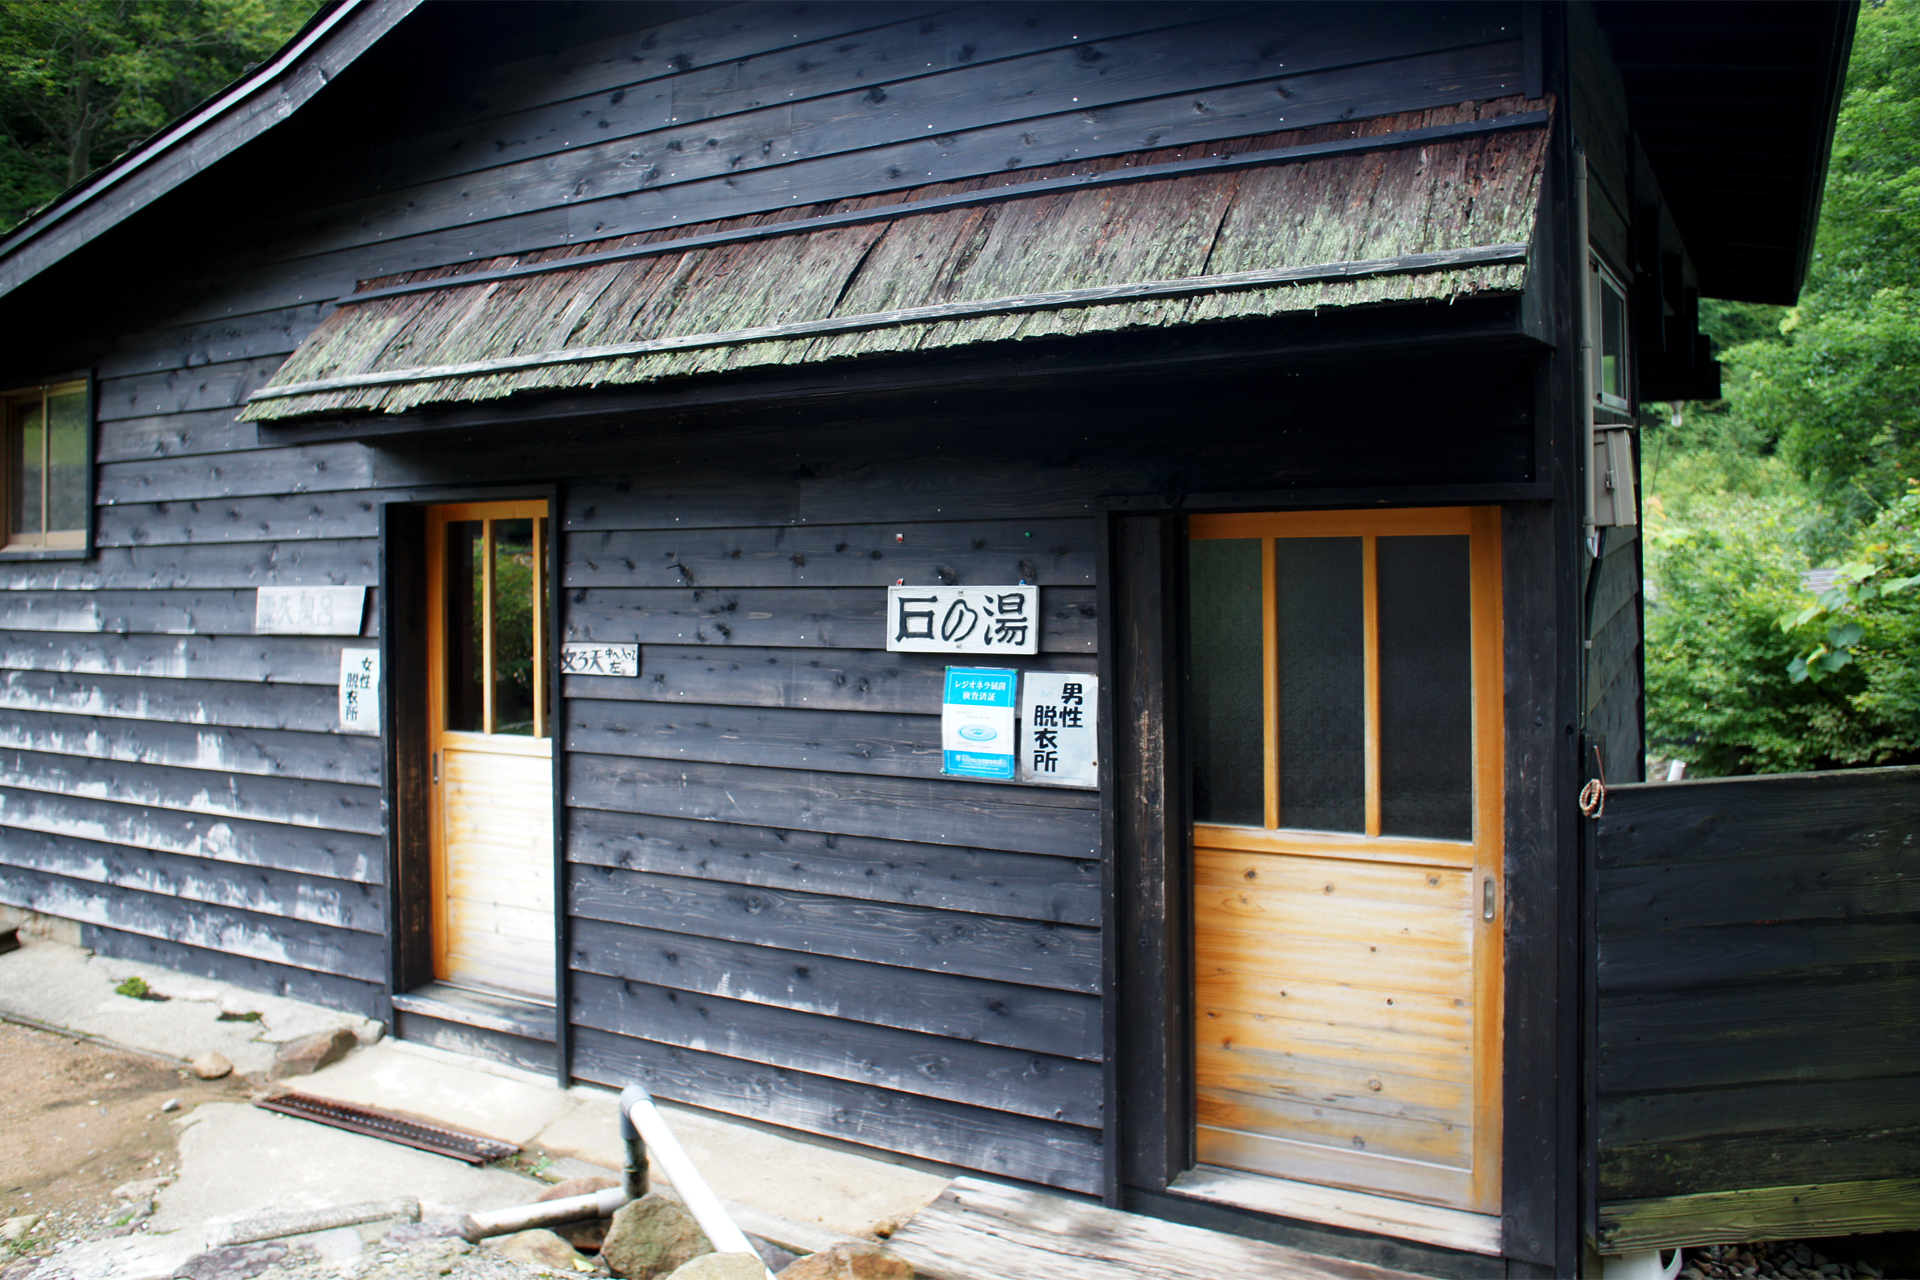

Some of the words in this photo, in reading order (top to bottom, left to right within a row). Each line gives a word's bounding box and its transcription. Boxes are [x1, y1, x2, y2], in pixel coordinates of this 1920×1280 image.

[359, 656, 373, 689] 女性
[954, 680, 1007, 691] レジオネラ属菌
[345, 672, 359, 722] 脱衣所
[1058, 682, 1083, 728] 男性
[1034, 704, 1058, 773] 脱衣所
